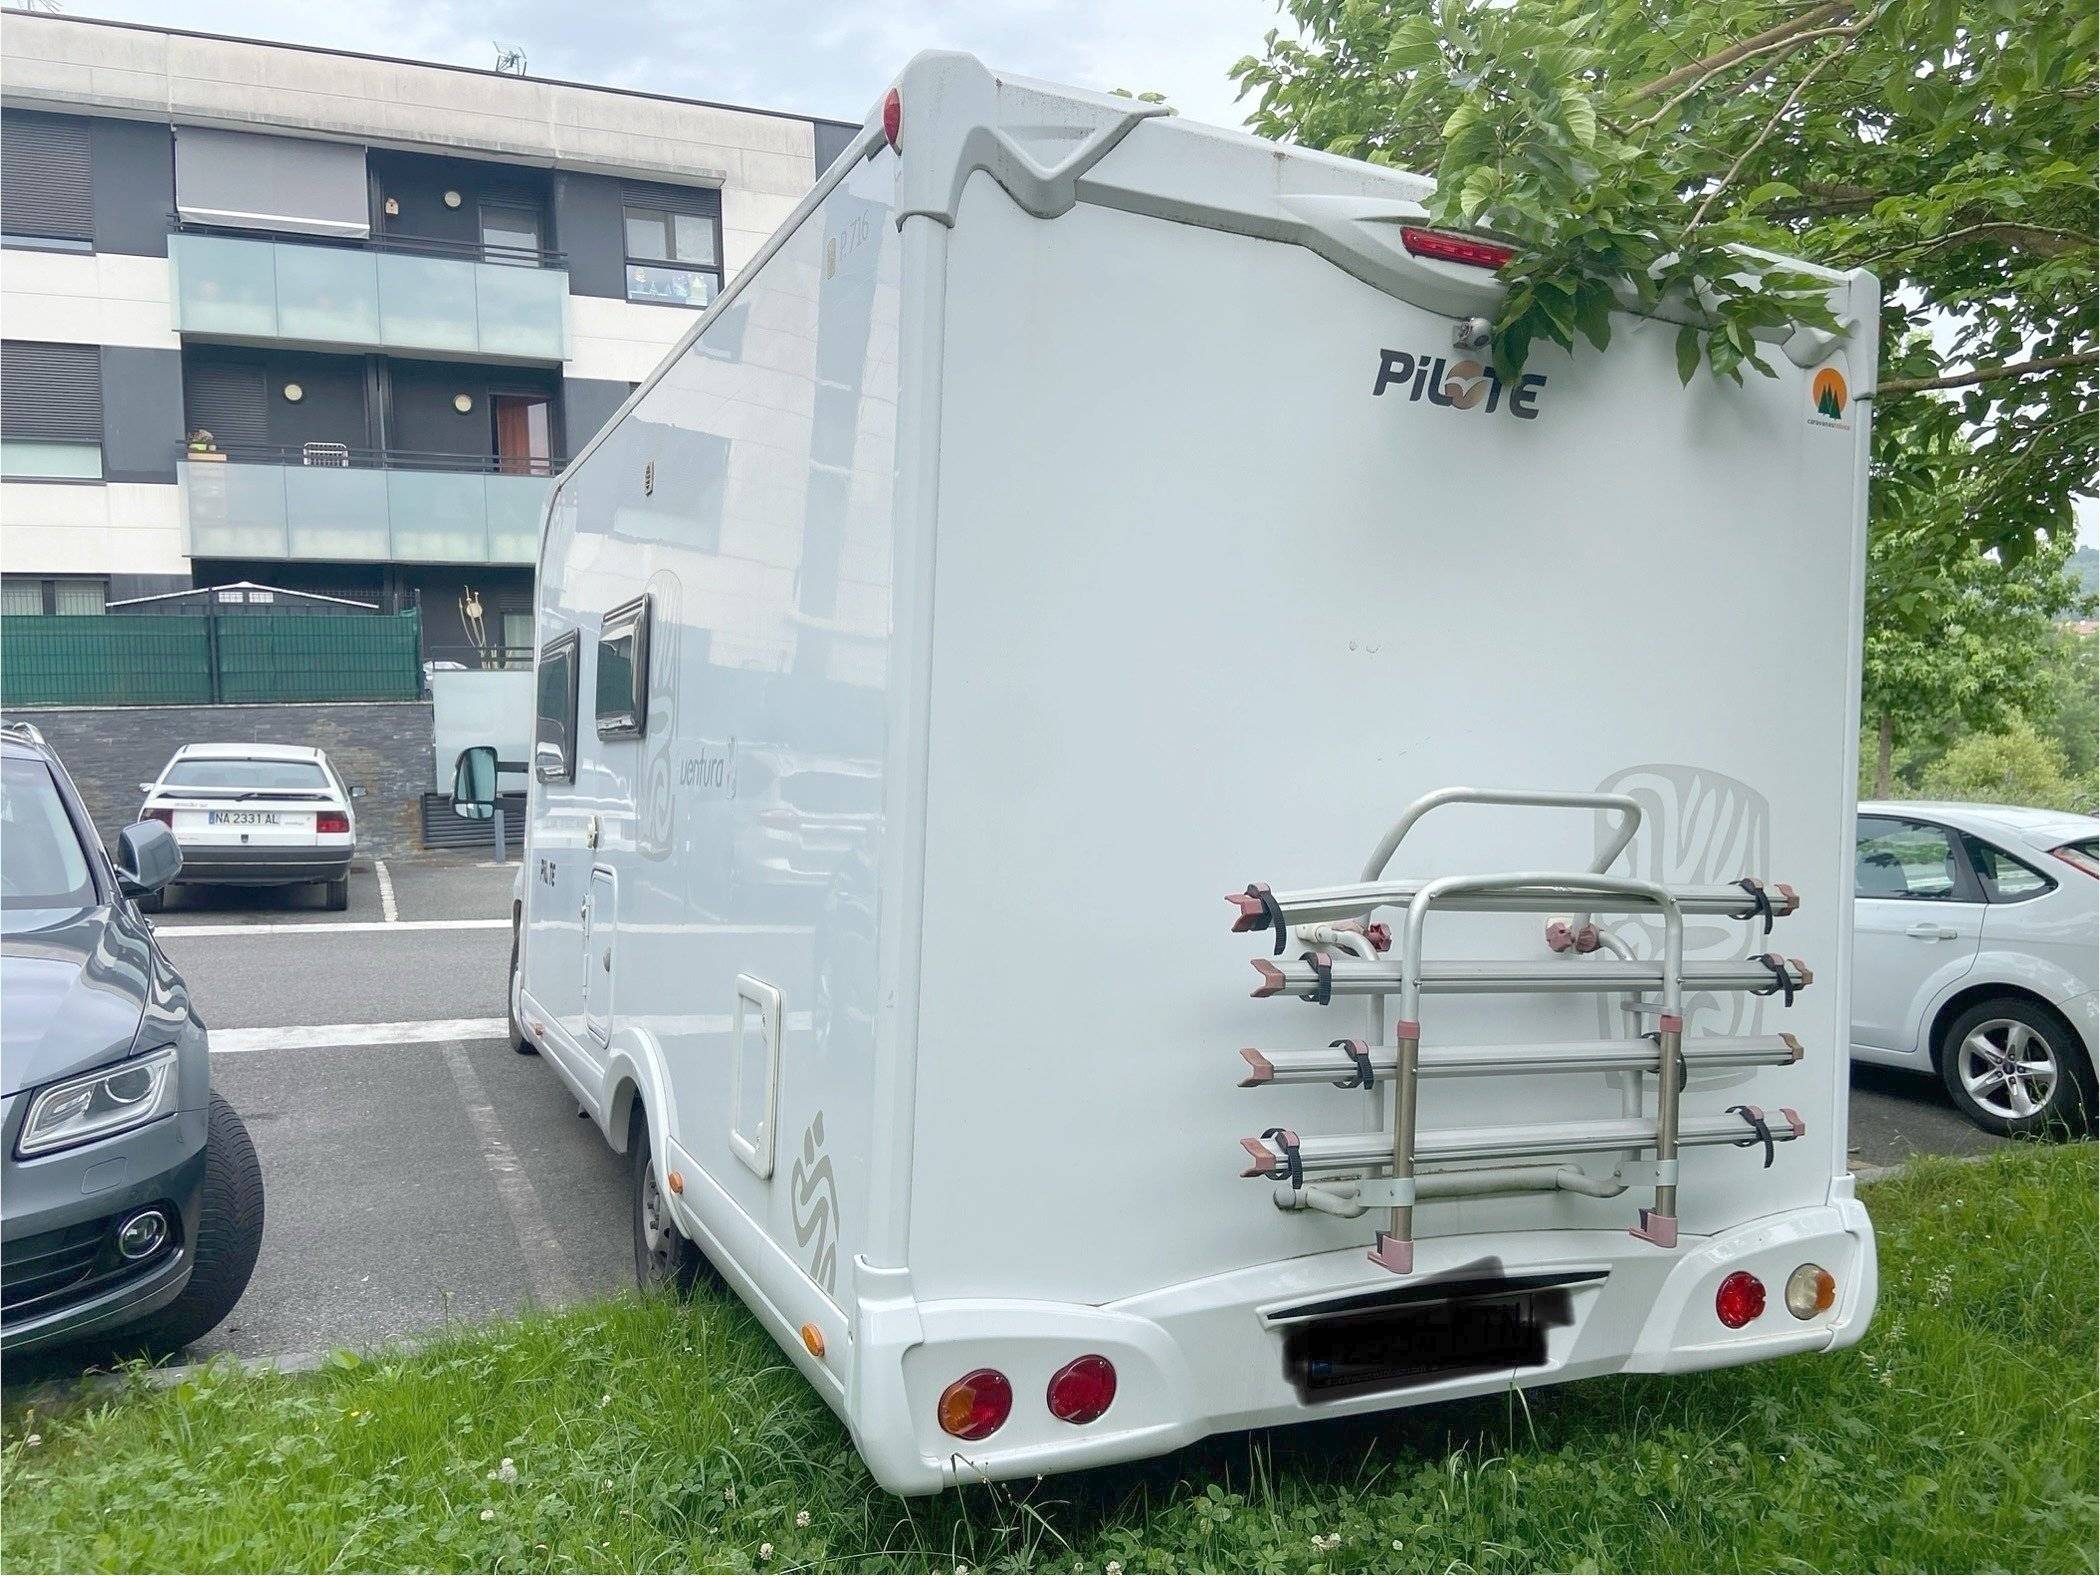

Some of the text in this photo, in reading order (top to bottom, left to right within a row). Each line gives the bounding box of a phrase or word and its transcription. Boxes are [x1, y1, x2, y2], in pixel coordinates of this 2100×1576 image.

[679, 746, 724, 788] ventura
[215, 812, 230, 824] NA
[233, 813, 262, 824] 2331
[265, 814, 279, 825] AL
